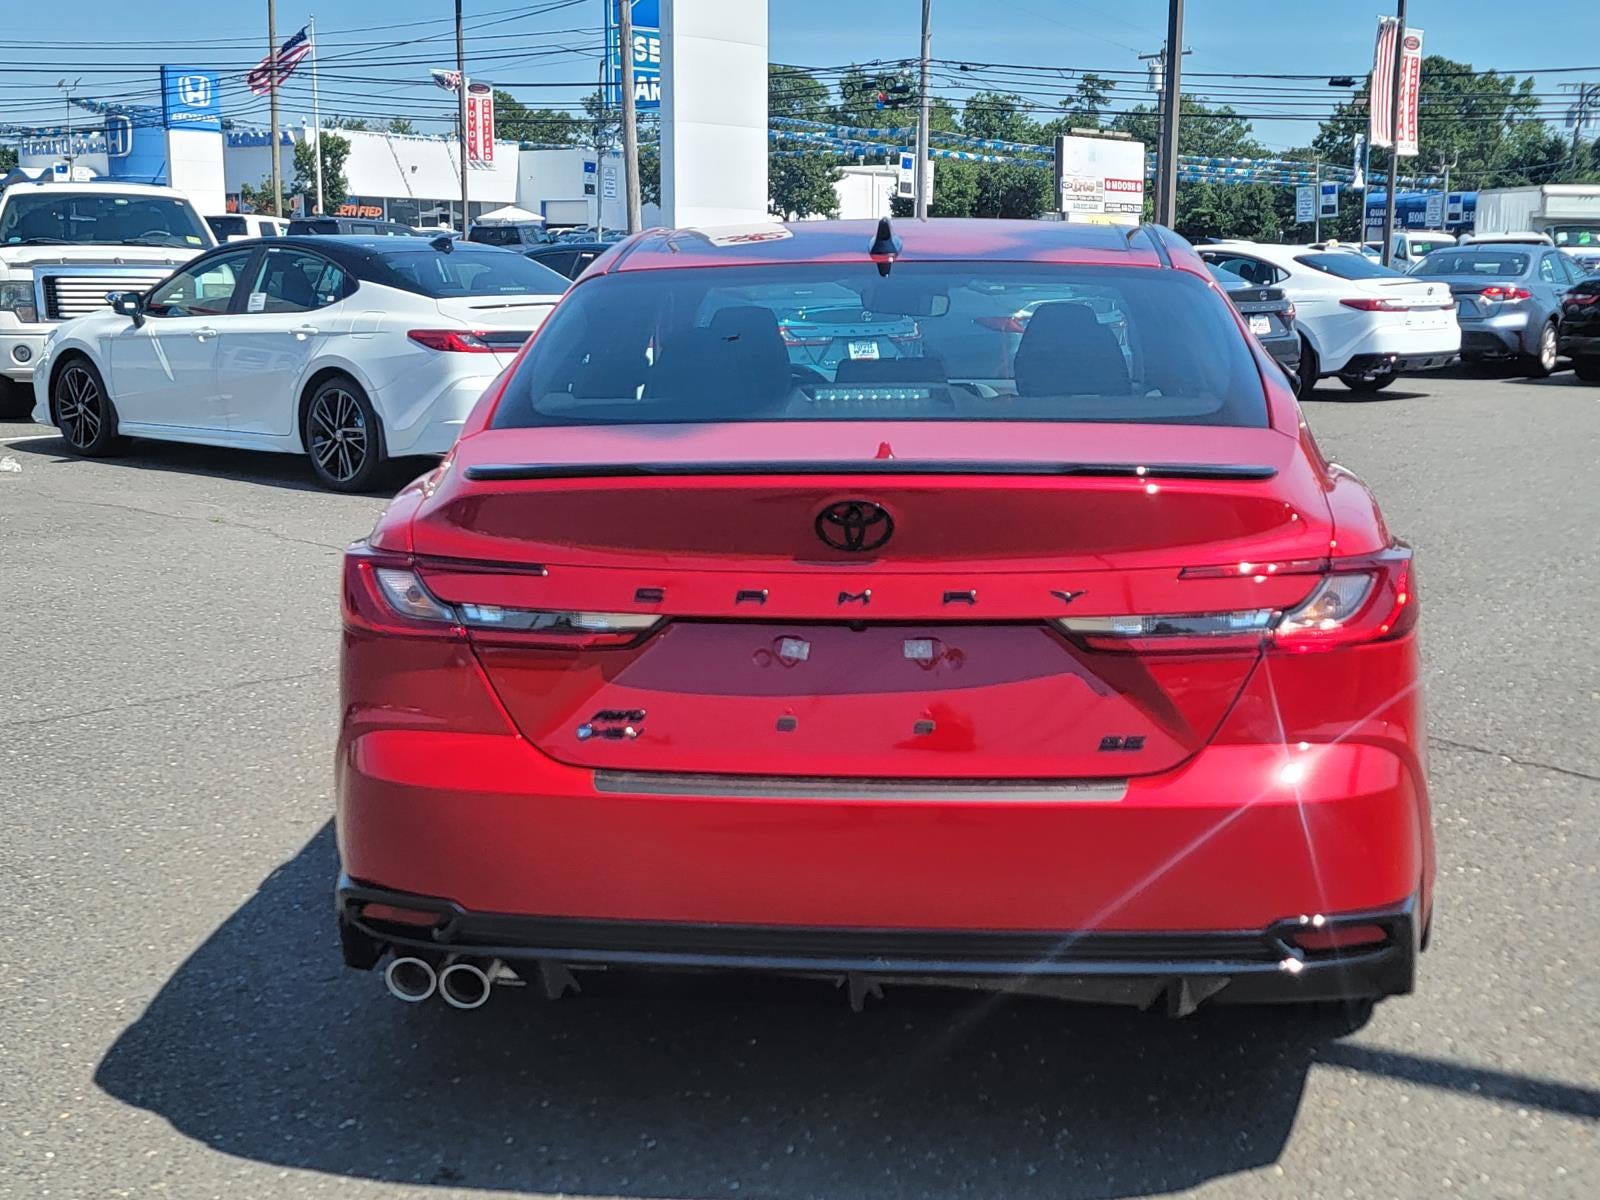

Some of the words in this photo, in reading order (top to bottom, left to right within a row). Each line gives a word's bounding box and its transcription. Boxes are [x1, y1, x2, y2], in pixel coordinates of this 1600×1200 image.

[1409, 59, 1418, 141] CERTIFIED
[469, 100, 477, 159] TOYOTA
[483, 100, 492, 160] CERTIFIED
[1111, 180, 1136, 191] MOOSE
[1408, 211, 1426, 223] HON
[633, 587, 1090, 605] CAMRY
[1097, 735, 1147, 752] SE
